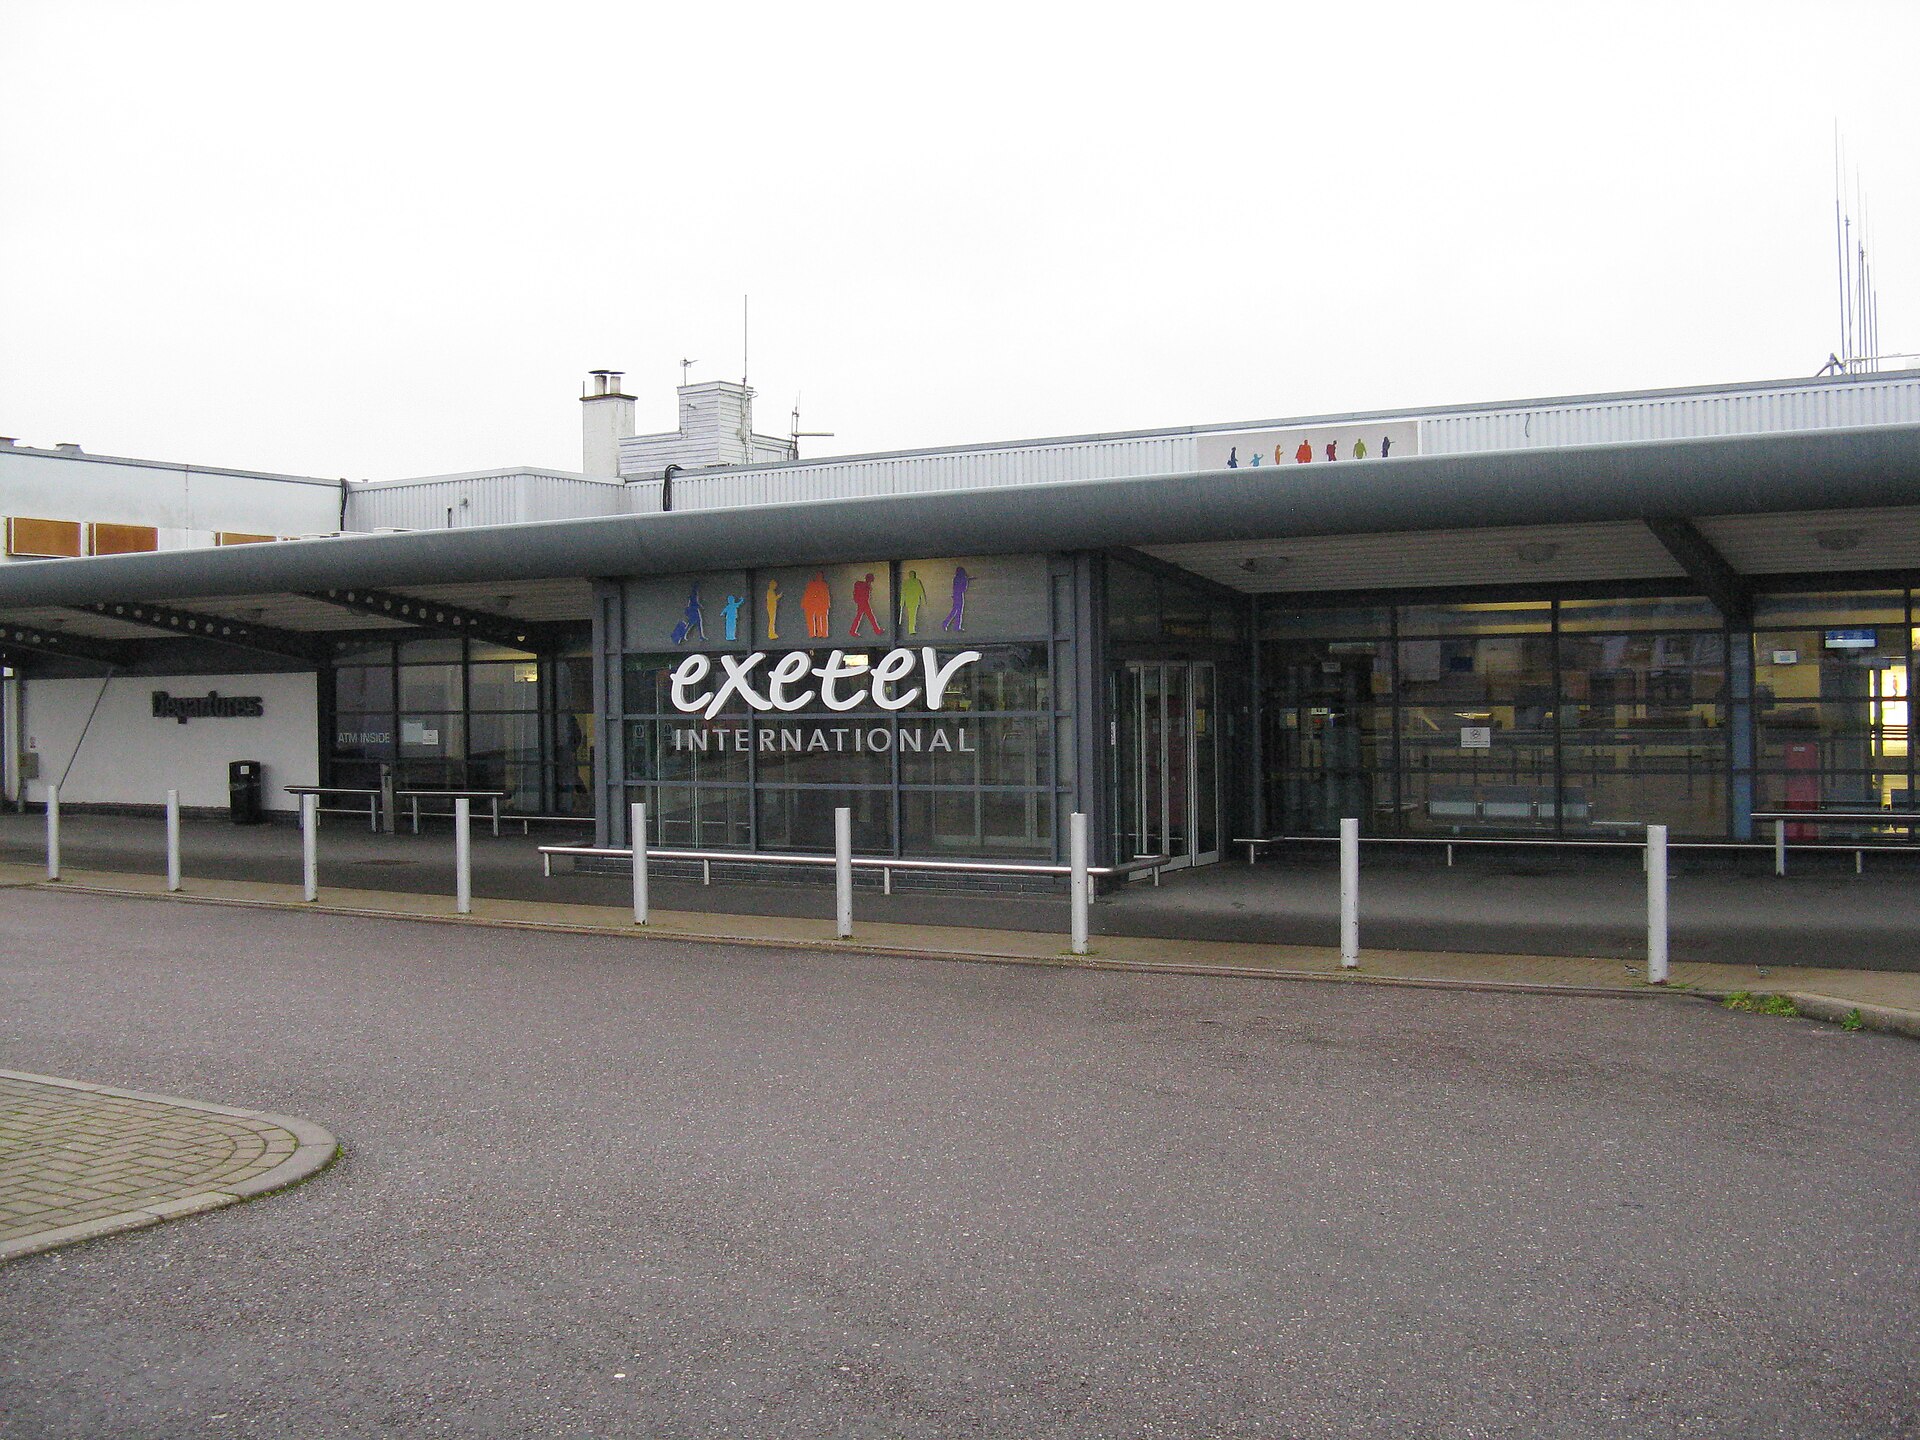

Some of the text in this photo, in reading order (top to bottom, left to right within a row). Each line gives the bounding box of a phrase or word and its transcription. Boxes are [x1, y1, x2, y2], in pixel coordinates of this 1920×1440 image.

[669, 646, 983, 720] exeter
[152, 690, 264, 724] Departures
[338, 732, 390, 743] ATM INSIDE
[675, 728, 976, 752] INTERNATIONAL
